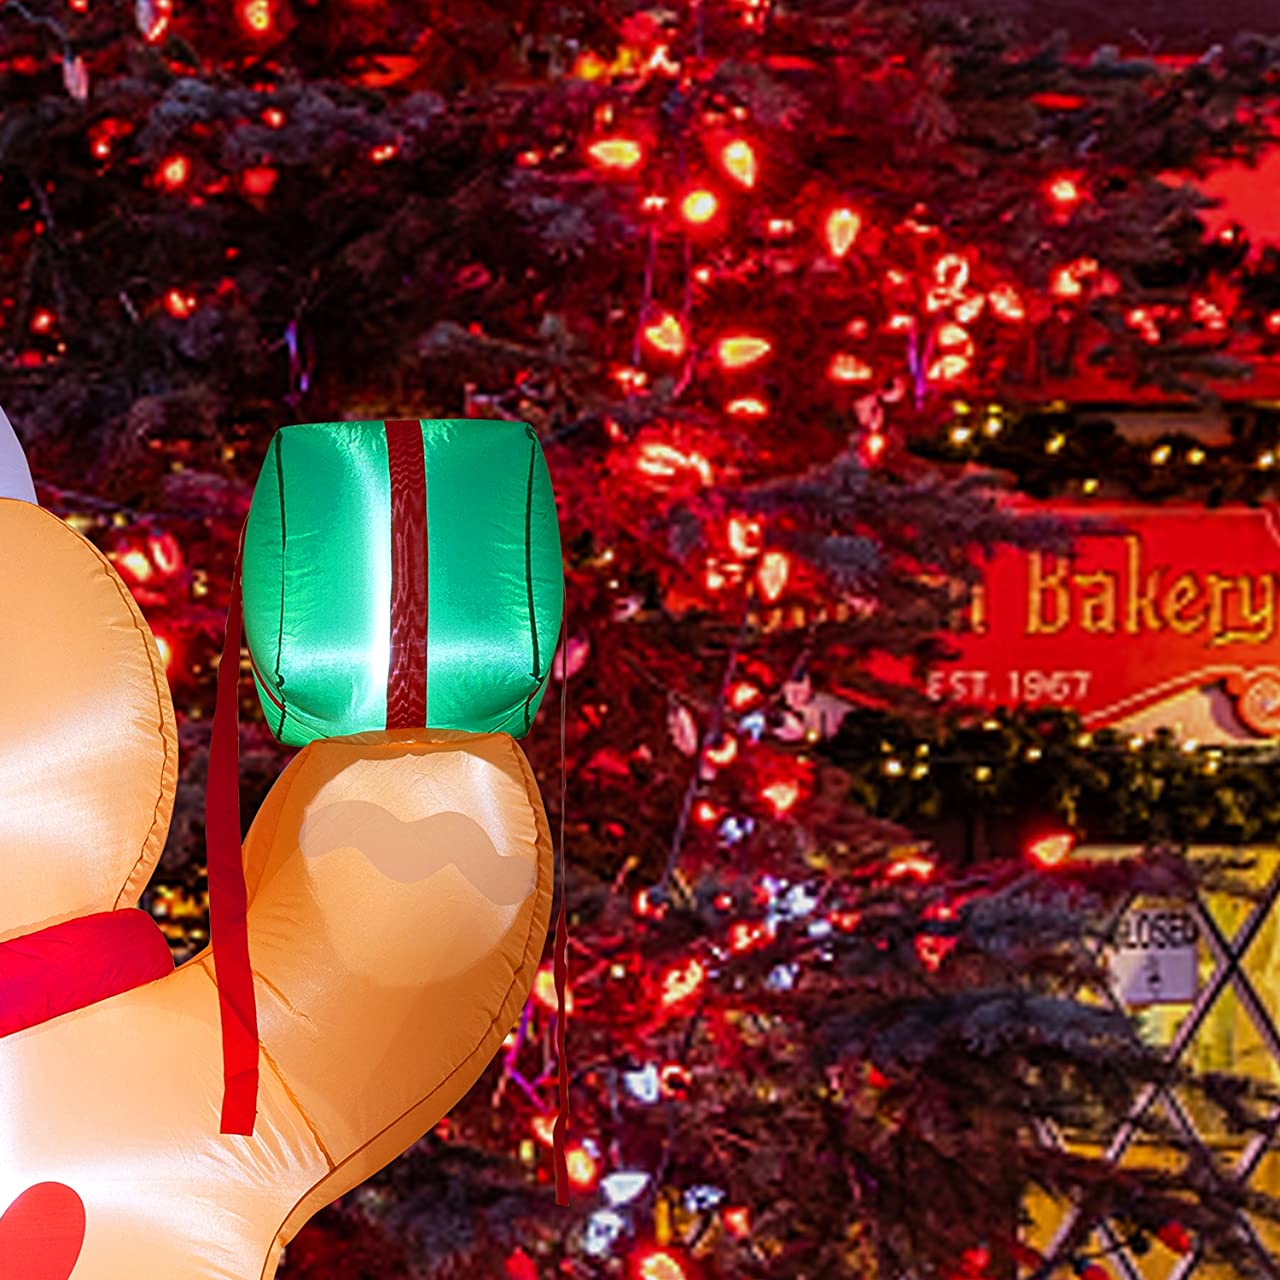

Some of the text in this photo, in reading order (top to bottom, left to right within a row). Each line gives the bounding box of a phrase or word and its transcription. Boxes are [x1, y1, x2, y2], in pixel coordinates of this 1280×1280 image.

[1026, 534, 1274, 646] Bakery
[926, 669, 1093, 702] EST. 1967
